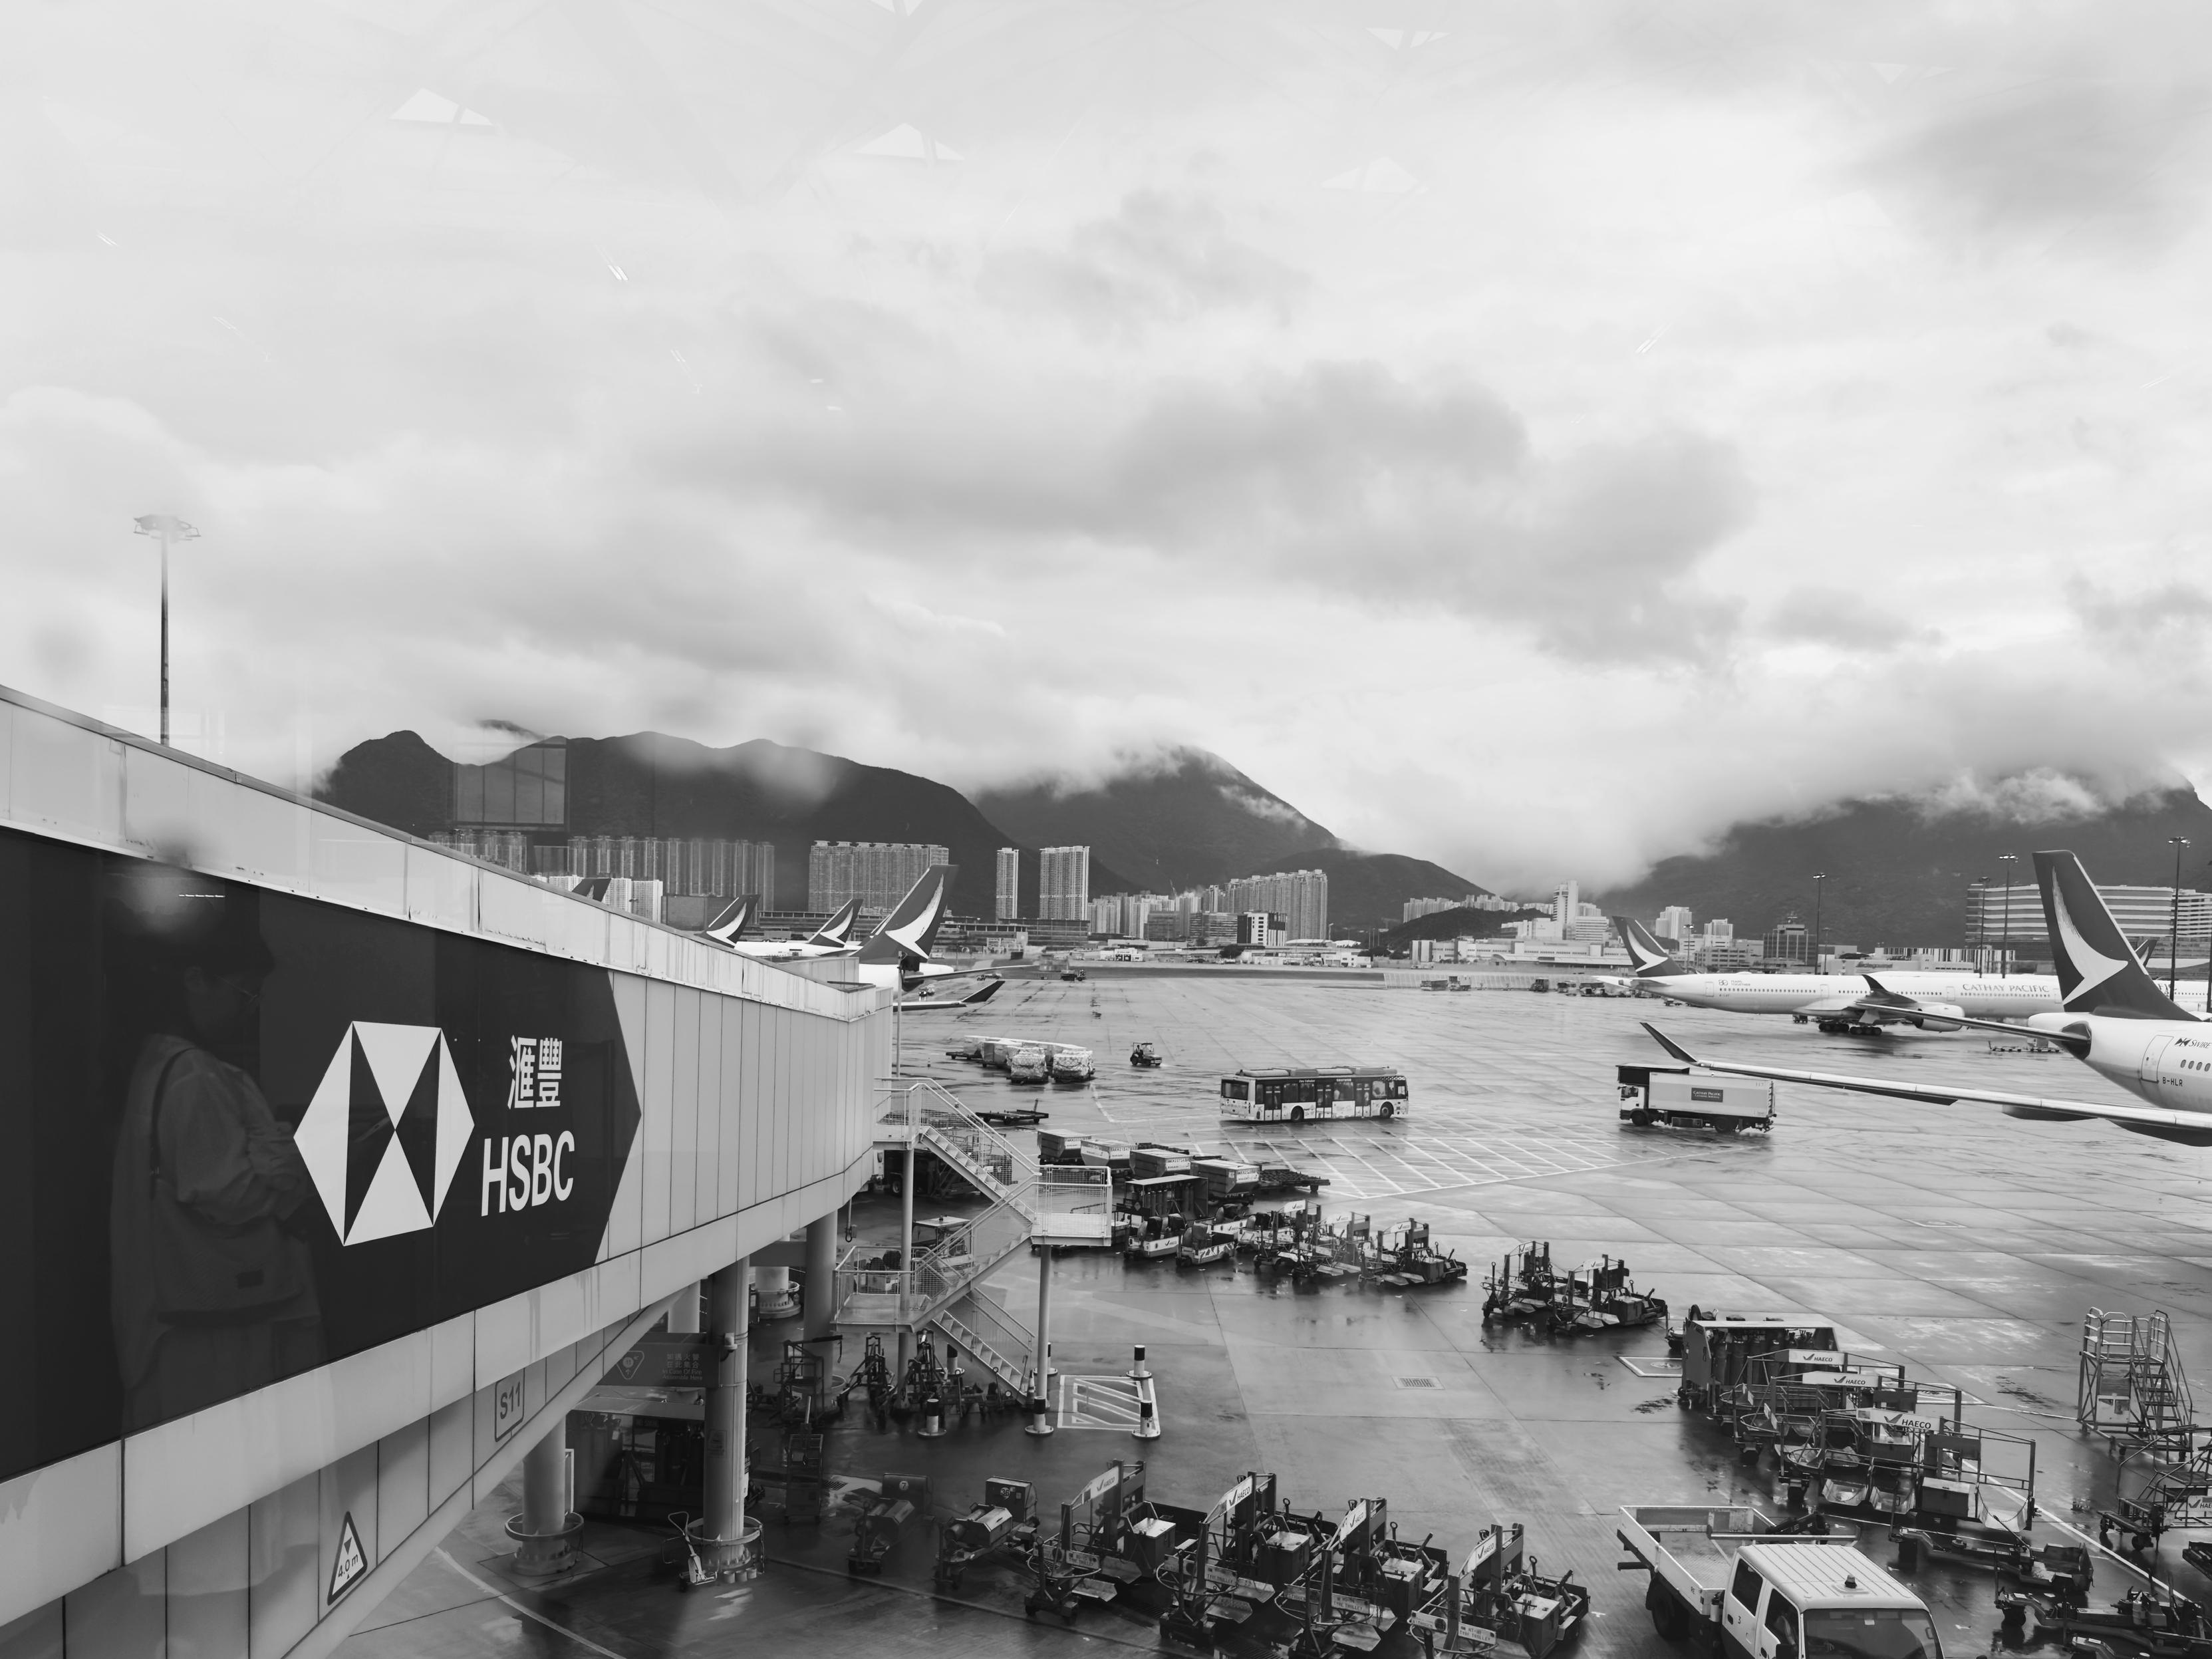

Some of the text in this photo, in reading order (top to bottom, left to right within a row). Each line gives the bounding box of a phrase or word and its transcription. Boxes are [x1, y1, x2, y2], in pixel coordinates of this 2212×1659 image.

[2189, 1039, 2211, 1049] SWIRE
[2162, 1076, 2183, 1087] B-HLR
[481, 1130, 575, 1217] HSBC
[499, 1381, 521, 1420] S11
[1901, 1418, 1931, 1429] HAECO
[1237, 1486, 1250, 1500] HAECO
[1483, 1543, 1494, 1555] HAECO
[338, 1553, 358, 1578] 4.0 m
[1738, 1615, 1742, 1624] 3
